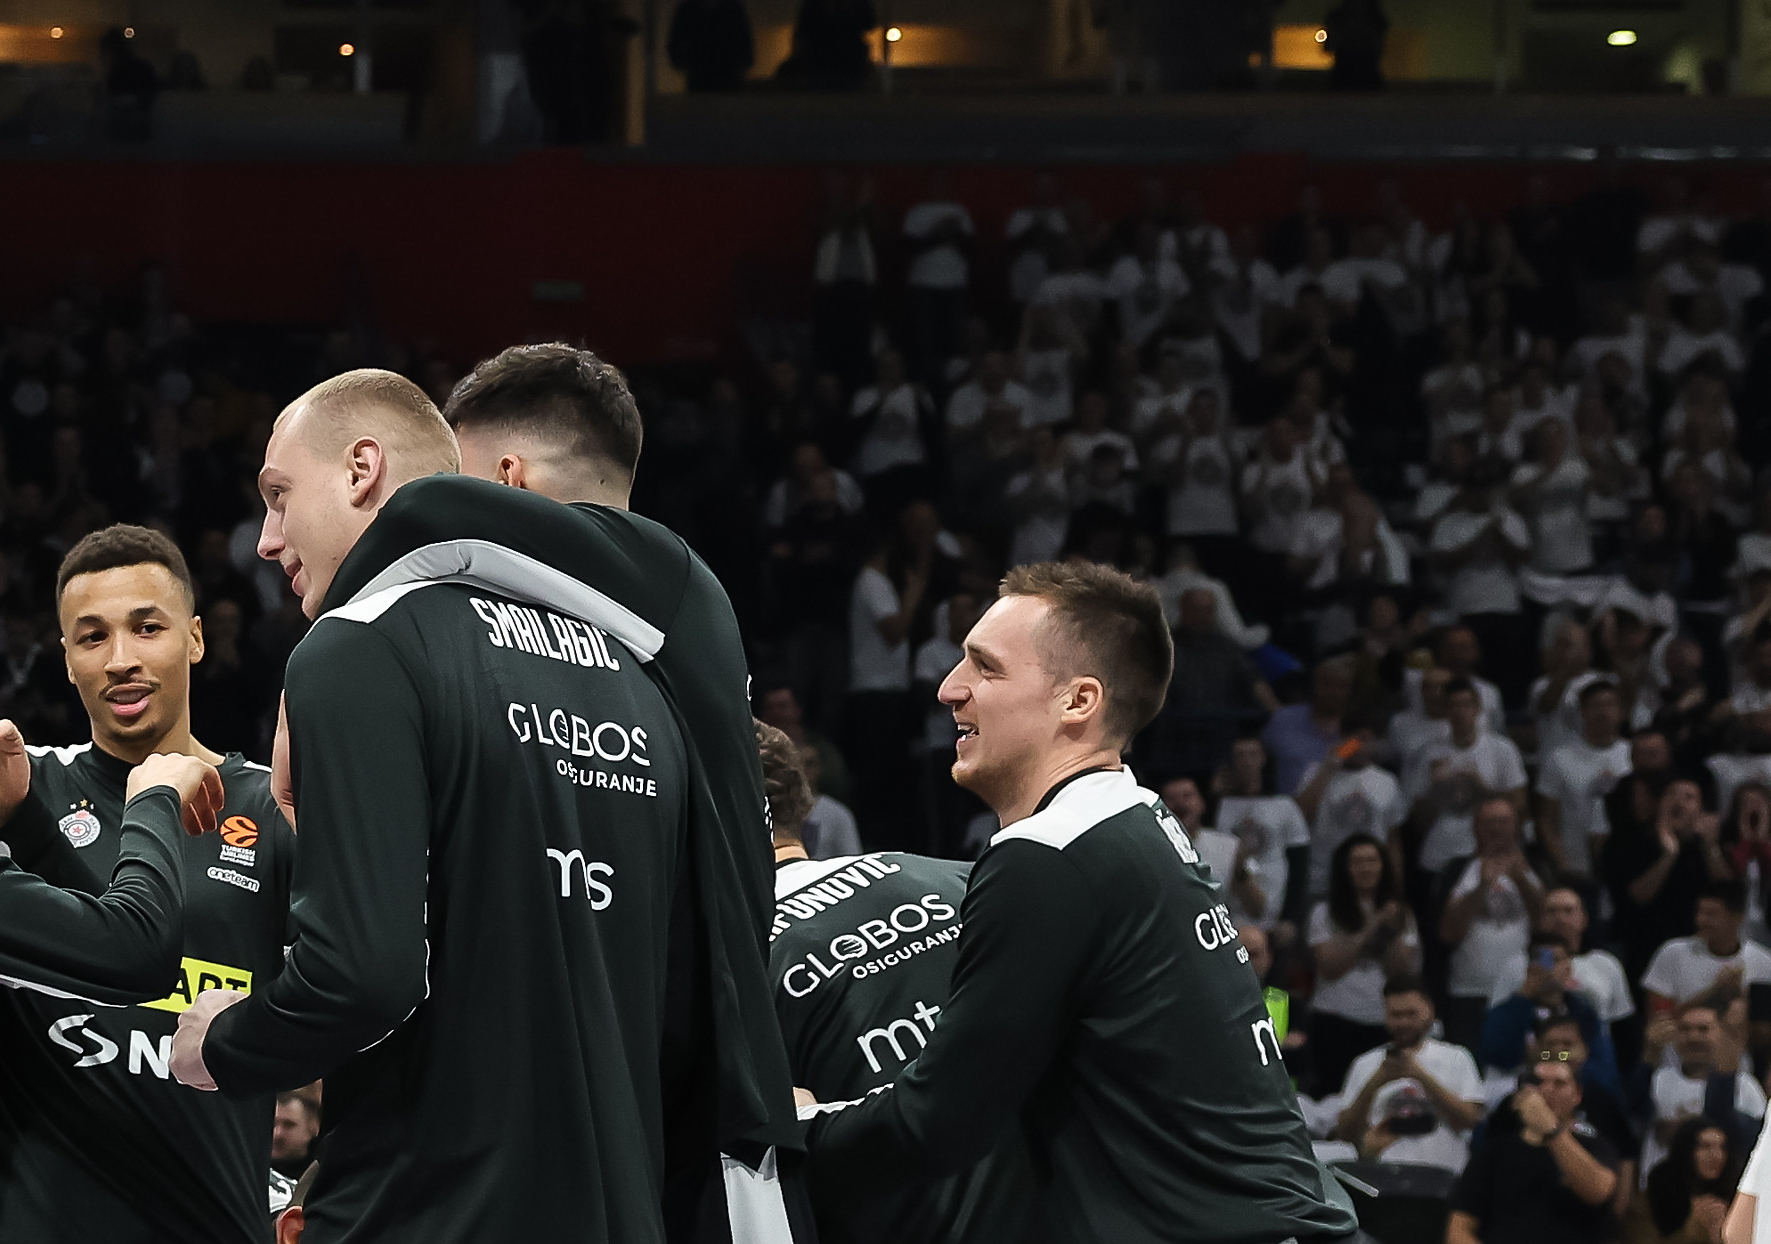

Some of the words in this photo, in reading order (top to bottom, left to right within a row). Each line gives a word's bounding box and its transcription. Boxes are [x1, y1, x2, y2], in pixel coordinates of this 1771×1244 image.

[507, 702, 651, 767] GLOBOS
[783, 894, 956, 998] GLOBOS
[852, 923, 964, 979] OSIGURANJ
